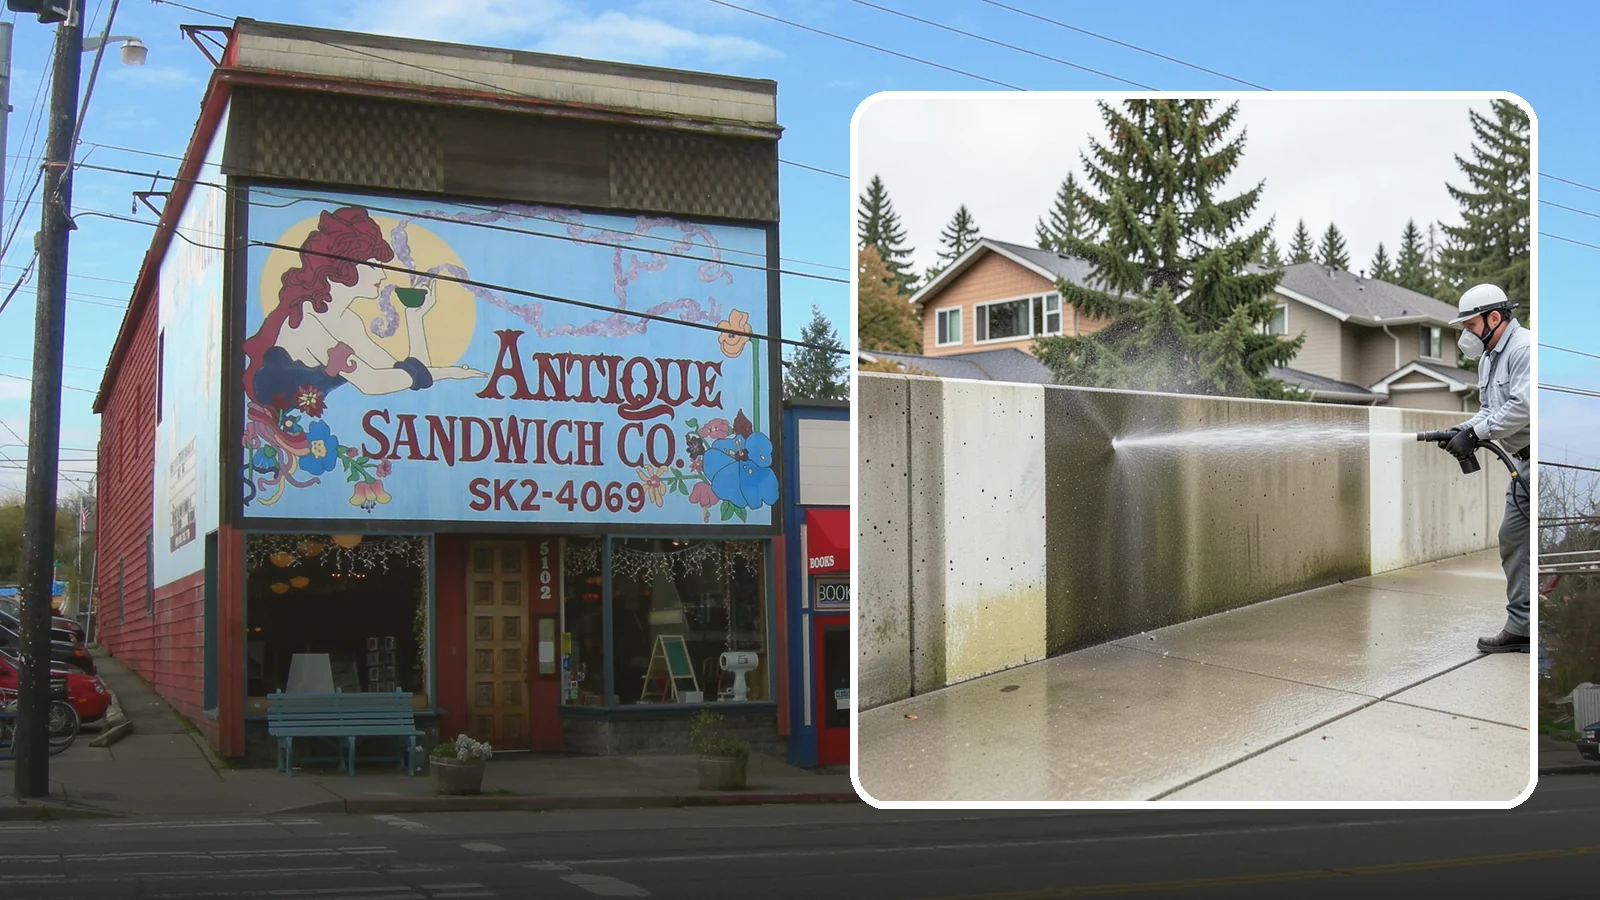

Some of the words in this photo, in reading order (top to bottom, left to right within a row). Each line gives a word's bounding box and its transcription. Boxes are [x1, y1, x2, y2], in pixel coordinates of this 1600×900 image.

[476, 329, 723, 421] ANTIQUE
[361, 408, 604, 467] SANDWICH
[617, 421, 685, 468] CO.
[468, 477, 646, 513] SK2-4069
[540, 541, 552, 600] 5102
[809, 555, 835, 569] BOOKS
